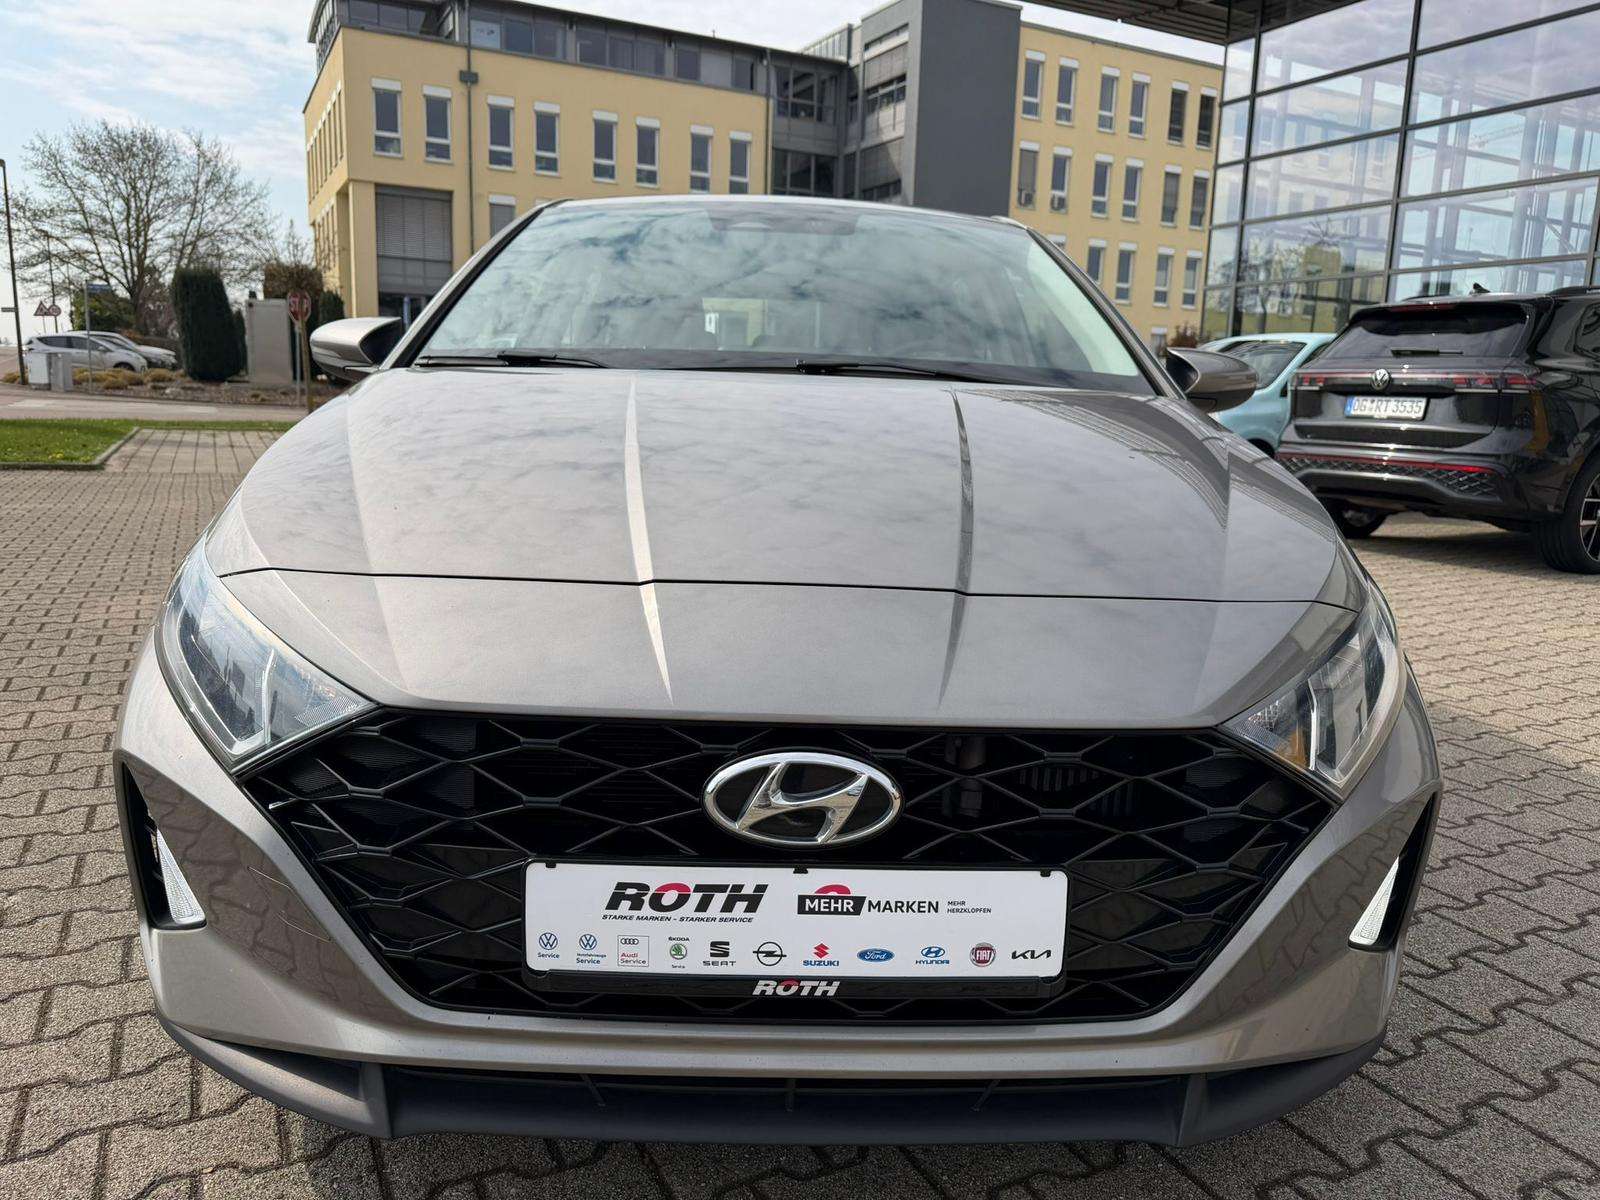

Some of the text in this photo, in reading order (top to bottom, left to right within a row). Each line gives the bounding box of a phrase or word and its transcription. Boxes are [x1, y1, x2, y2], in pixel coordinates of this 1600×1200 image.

[604, 881, 769, 913] ROTH
[805, 898, 939, 914] MEHR MARKEN
[864, 949, 887, 960] Ford
[976, 950, 992, 961] FIAT
[576, 957, 601, 965] Service
[802, 959, 840, 967] SUZUKI
[752, 978, 841, 996] ROTH
